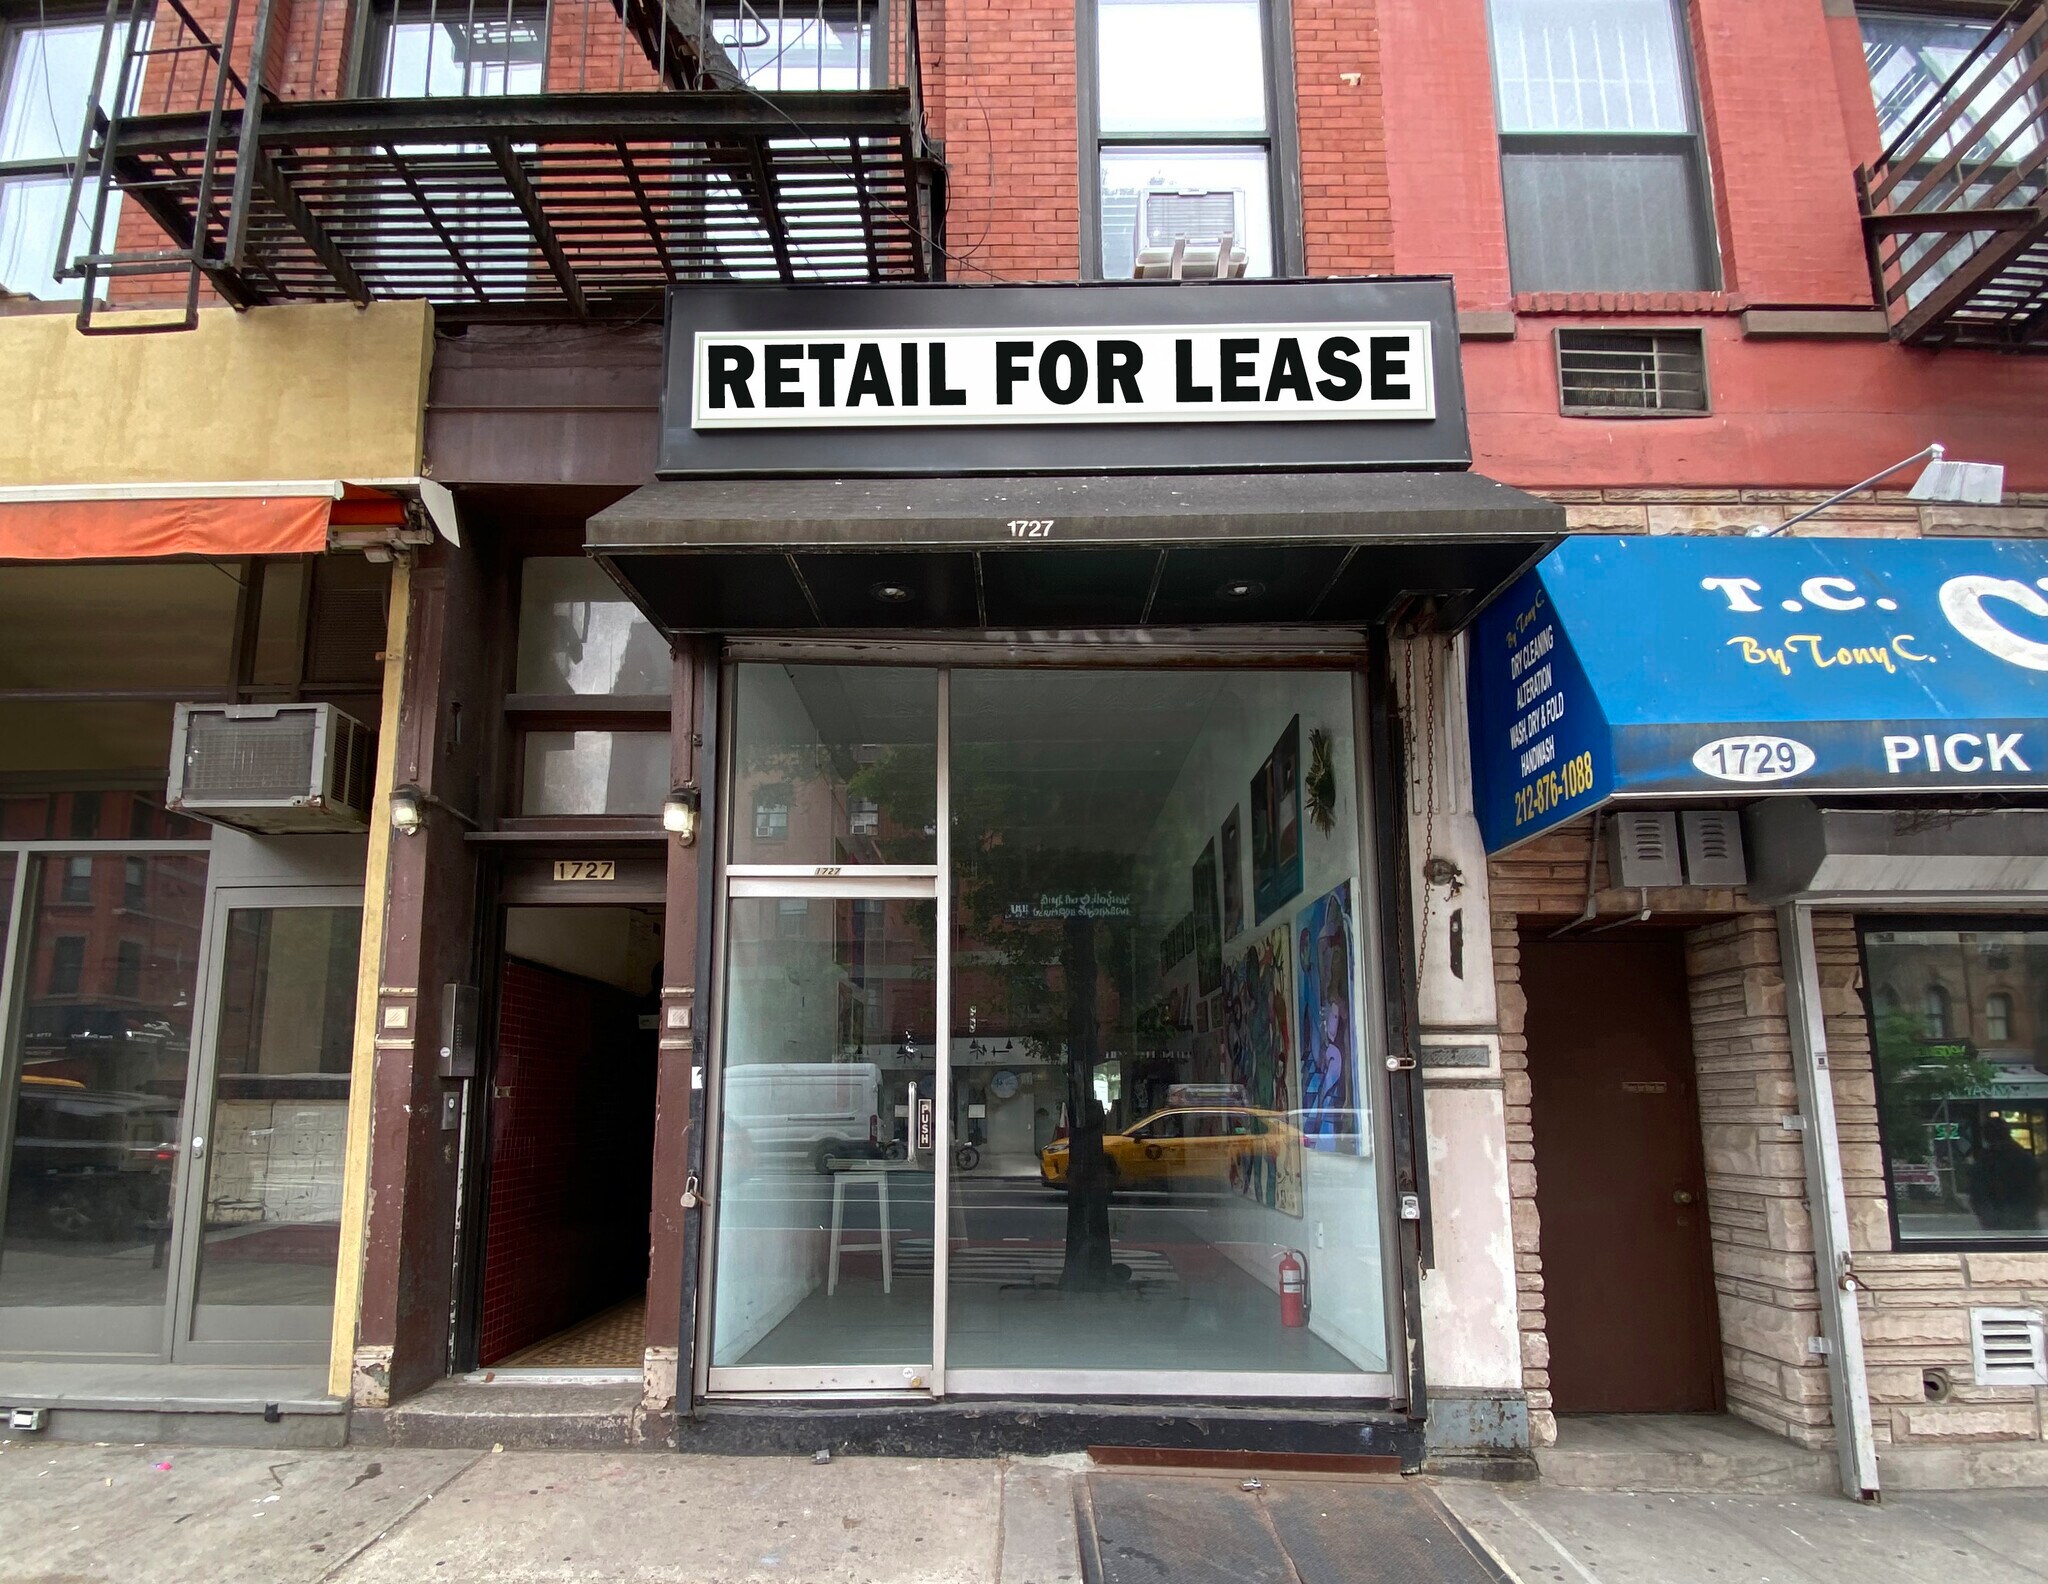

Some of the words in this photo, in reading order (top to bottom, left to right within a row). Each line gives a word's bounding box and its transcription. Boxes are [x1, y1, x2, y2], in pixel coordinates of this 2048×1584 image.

[707, 341, 967, 409] RETAIL
[996, 339, 1144, 405] FOR
[1175, 335, 1412, 403] LEASE
[1007, 520, 1054, 537] 1727
[1701, 577, 1898, 612] T.C.
[1511, 650, 1523, 680] DRY
[1523, 624, 1553, 670] CLEANING
[1726, 636, 1791, 675] By
[1784, 634, 1896, 674] Tony
[1892, 634, 1937, 663] C.
[1516, 662, 1553, 711] ALTERATION
[1510, 715, 1529, 750] WASH,
[1527, 707, 1541, 738] DRY
[1540, 703, 1547, 730] &
[1546, 691, 1564, 727] FOLD
[1521, 734, 1555, 778] HANDWASH
[1711, 742, 1796, 775] 1729
[1883, 733, 2031, 774] PICK
[1514, 750, 1594, 827] 212-876-1088
[559, 862, 613, 879] 1727
[815, 867, 842, 876] 1727
[921, 1104, 929, 1144] PUSH
